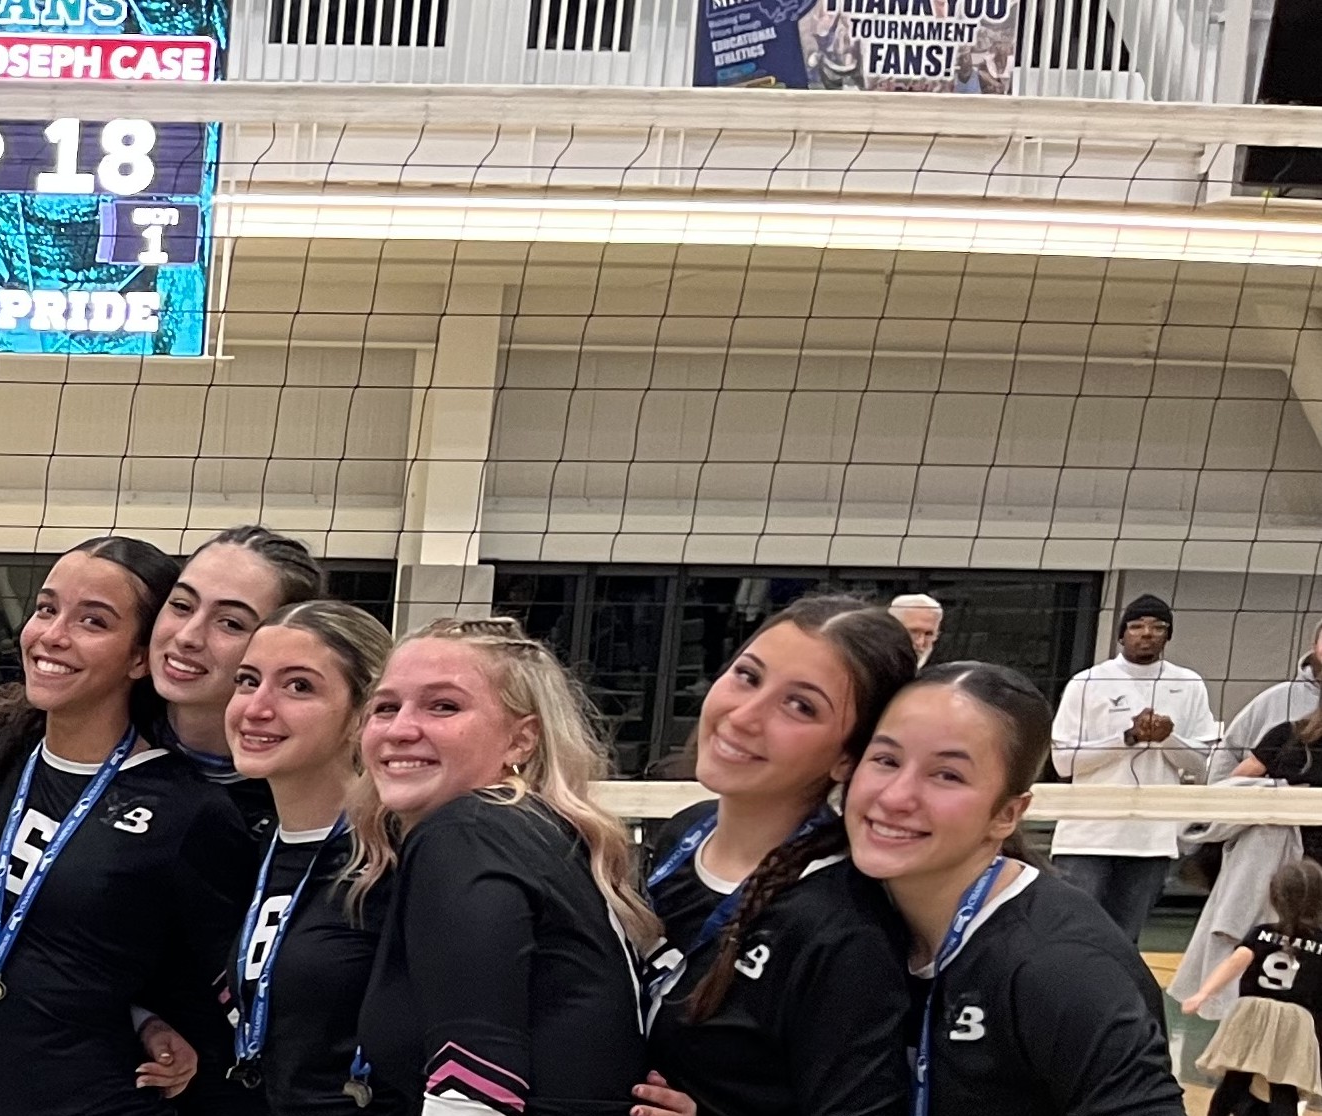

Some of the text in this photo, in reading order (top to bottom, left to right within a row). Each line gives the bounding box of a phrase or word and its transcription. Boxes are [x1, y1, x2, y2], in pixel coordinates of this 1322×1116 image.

[850, 18, 977, 43] TOURNAMENT
[107, 46, 206, 82] CASE
[869, 43, 955, 77] FANS!
[36, 117, 157, 196] 18
[138, 224, 169, 264] 1
[113, 807, 154, 834] B
[5, 808, 61, 895] 5
[245, 895, 293, 980] 6
[1258, 951, 1300, 991] 9
